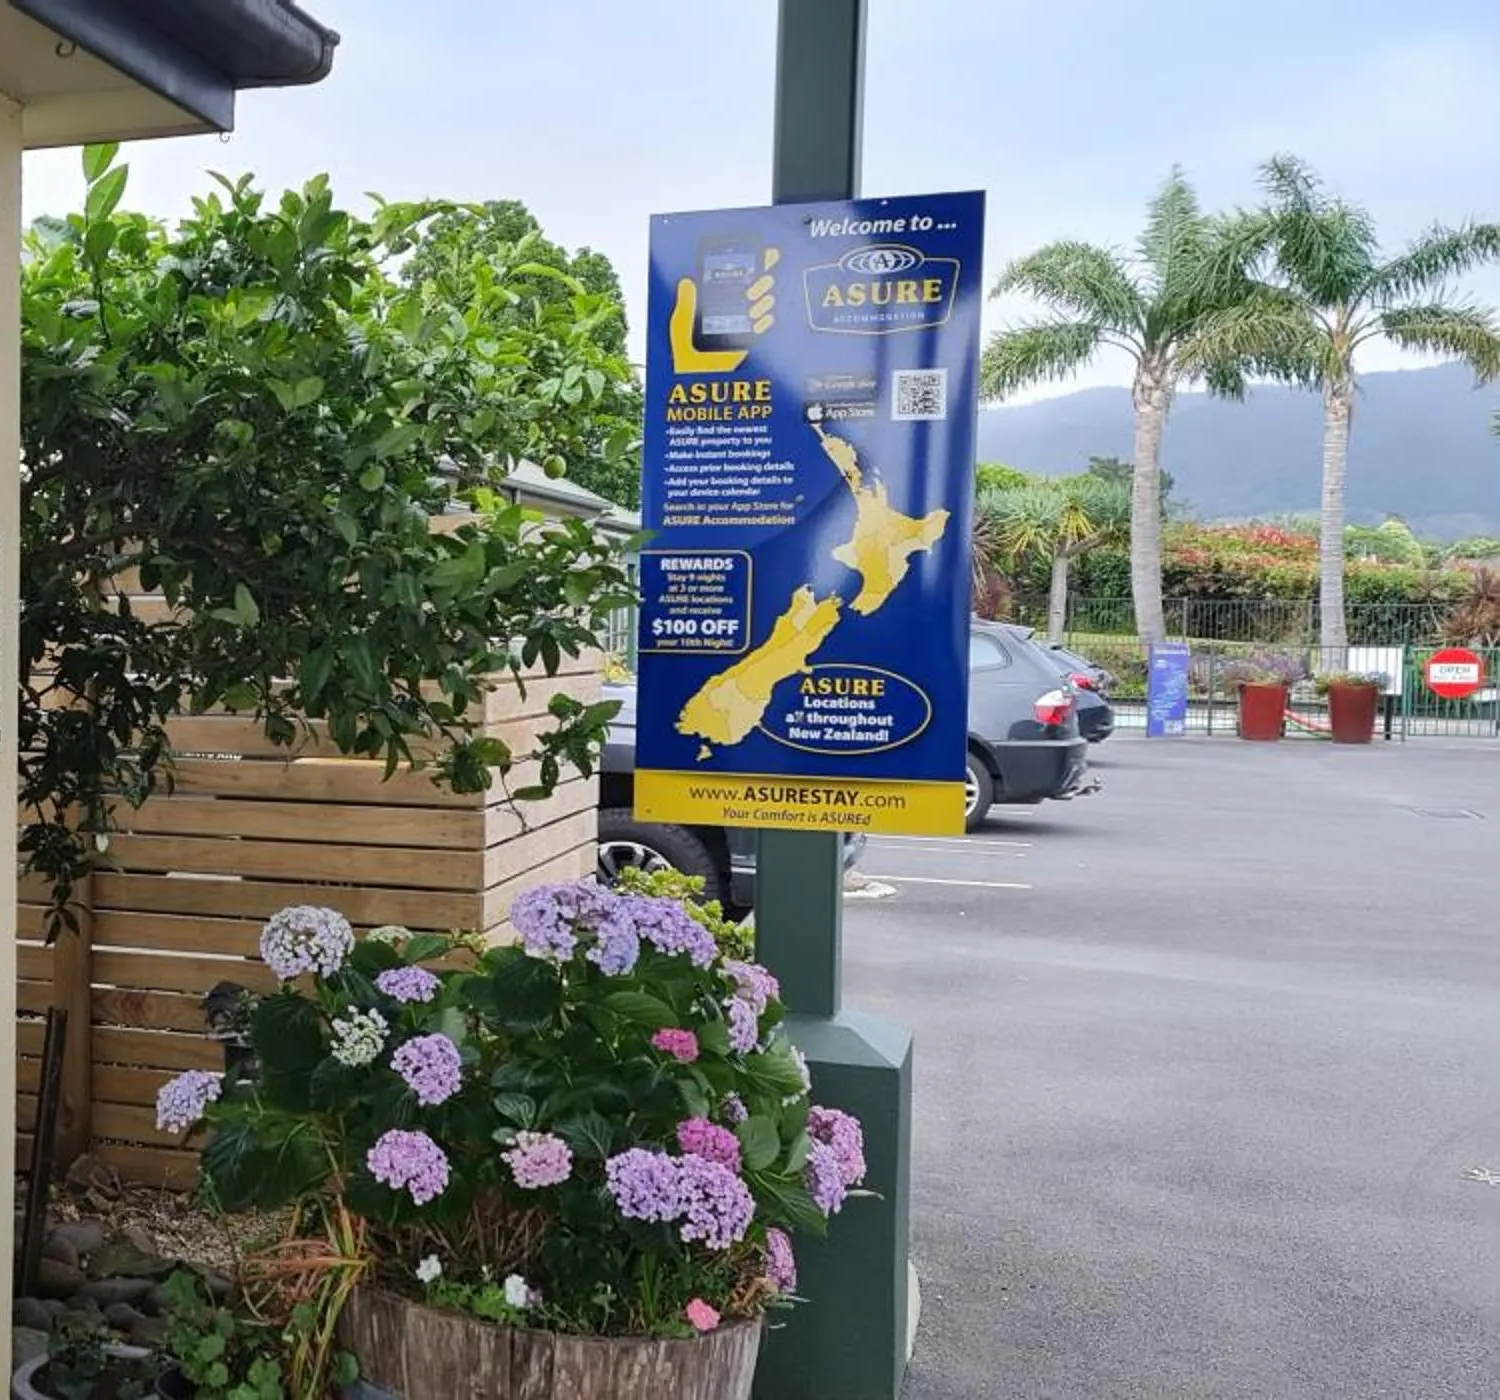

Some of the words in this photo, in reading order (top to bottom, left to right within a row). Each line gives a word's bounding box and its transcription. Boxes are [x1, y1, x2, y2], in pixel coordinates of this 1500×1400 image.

[810, 217, 906, 238] Welcome
[910, 214, 933, 231] to
[822, 278, 943, 307] ASURE
[669, 381, 772, 404] ASURE
[667, 406, 733, 422] MOBILE
[737, 405, 772, 420] APP
[826, 407, 848, 420] App
[848, 406, 875, 418] Store
[716, 425, 732, 434] the
[669, 437, 698, 446] ASURE
[700, 437, 740, 448] property
[743, 436, 753, 445] to
[754, 437, 773, 446] you
[723, 462, 762, 474] booking
[763, 460, 795, 472] details
[688, 478, 709, 488] your
[710, 476, 749, 487] booking
[750, 475, 782, 485] details
[783, 476, 794, 485] to
[667, 488, 689, 499] your
[690, 487, 720, 497] device
[721, 487, 761, 497] calendar
[664, 502, 695, 512] Search
[708, 503, 730, 513] your
[731, 501, 752, 512] App
[753, 501, 779, 511] Store
[780, 501, 795, 510] for
[664, 515, 701, 525] ASURE
[703, 514, 796, 525] Accommodation
[660, 557, 734, 571] REWARDS
[696, 573, 726, 584] nights
[668, 584, 679, 593] at
[687, 585, 698, 593] or
[699, 585, 725, 593] more
[691, 594, 734, 604] locations
[669, 606, 687, 615] and
[689, 606, 723, 615] receive
[652, 617, 698, 636] $100
[701, 619, 739, 636] OFF
[800, 677, 885, 696] ASURE
[803, 695, 876, 710] Locations
[806, 711, 894, 727] throughout
[789, 727, 821, 740] New
[823, 727, 889, 742] Zealand!
[689, 785, 906, 809] www.ASURESTAY.com
[723, 806, 749, 820] Your
[752, 808, 805, 823] Comfort
[807, 810, 818, 823] is
[820, 812, 872, 826] ASUREd
